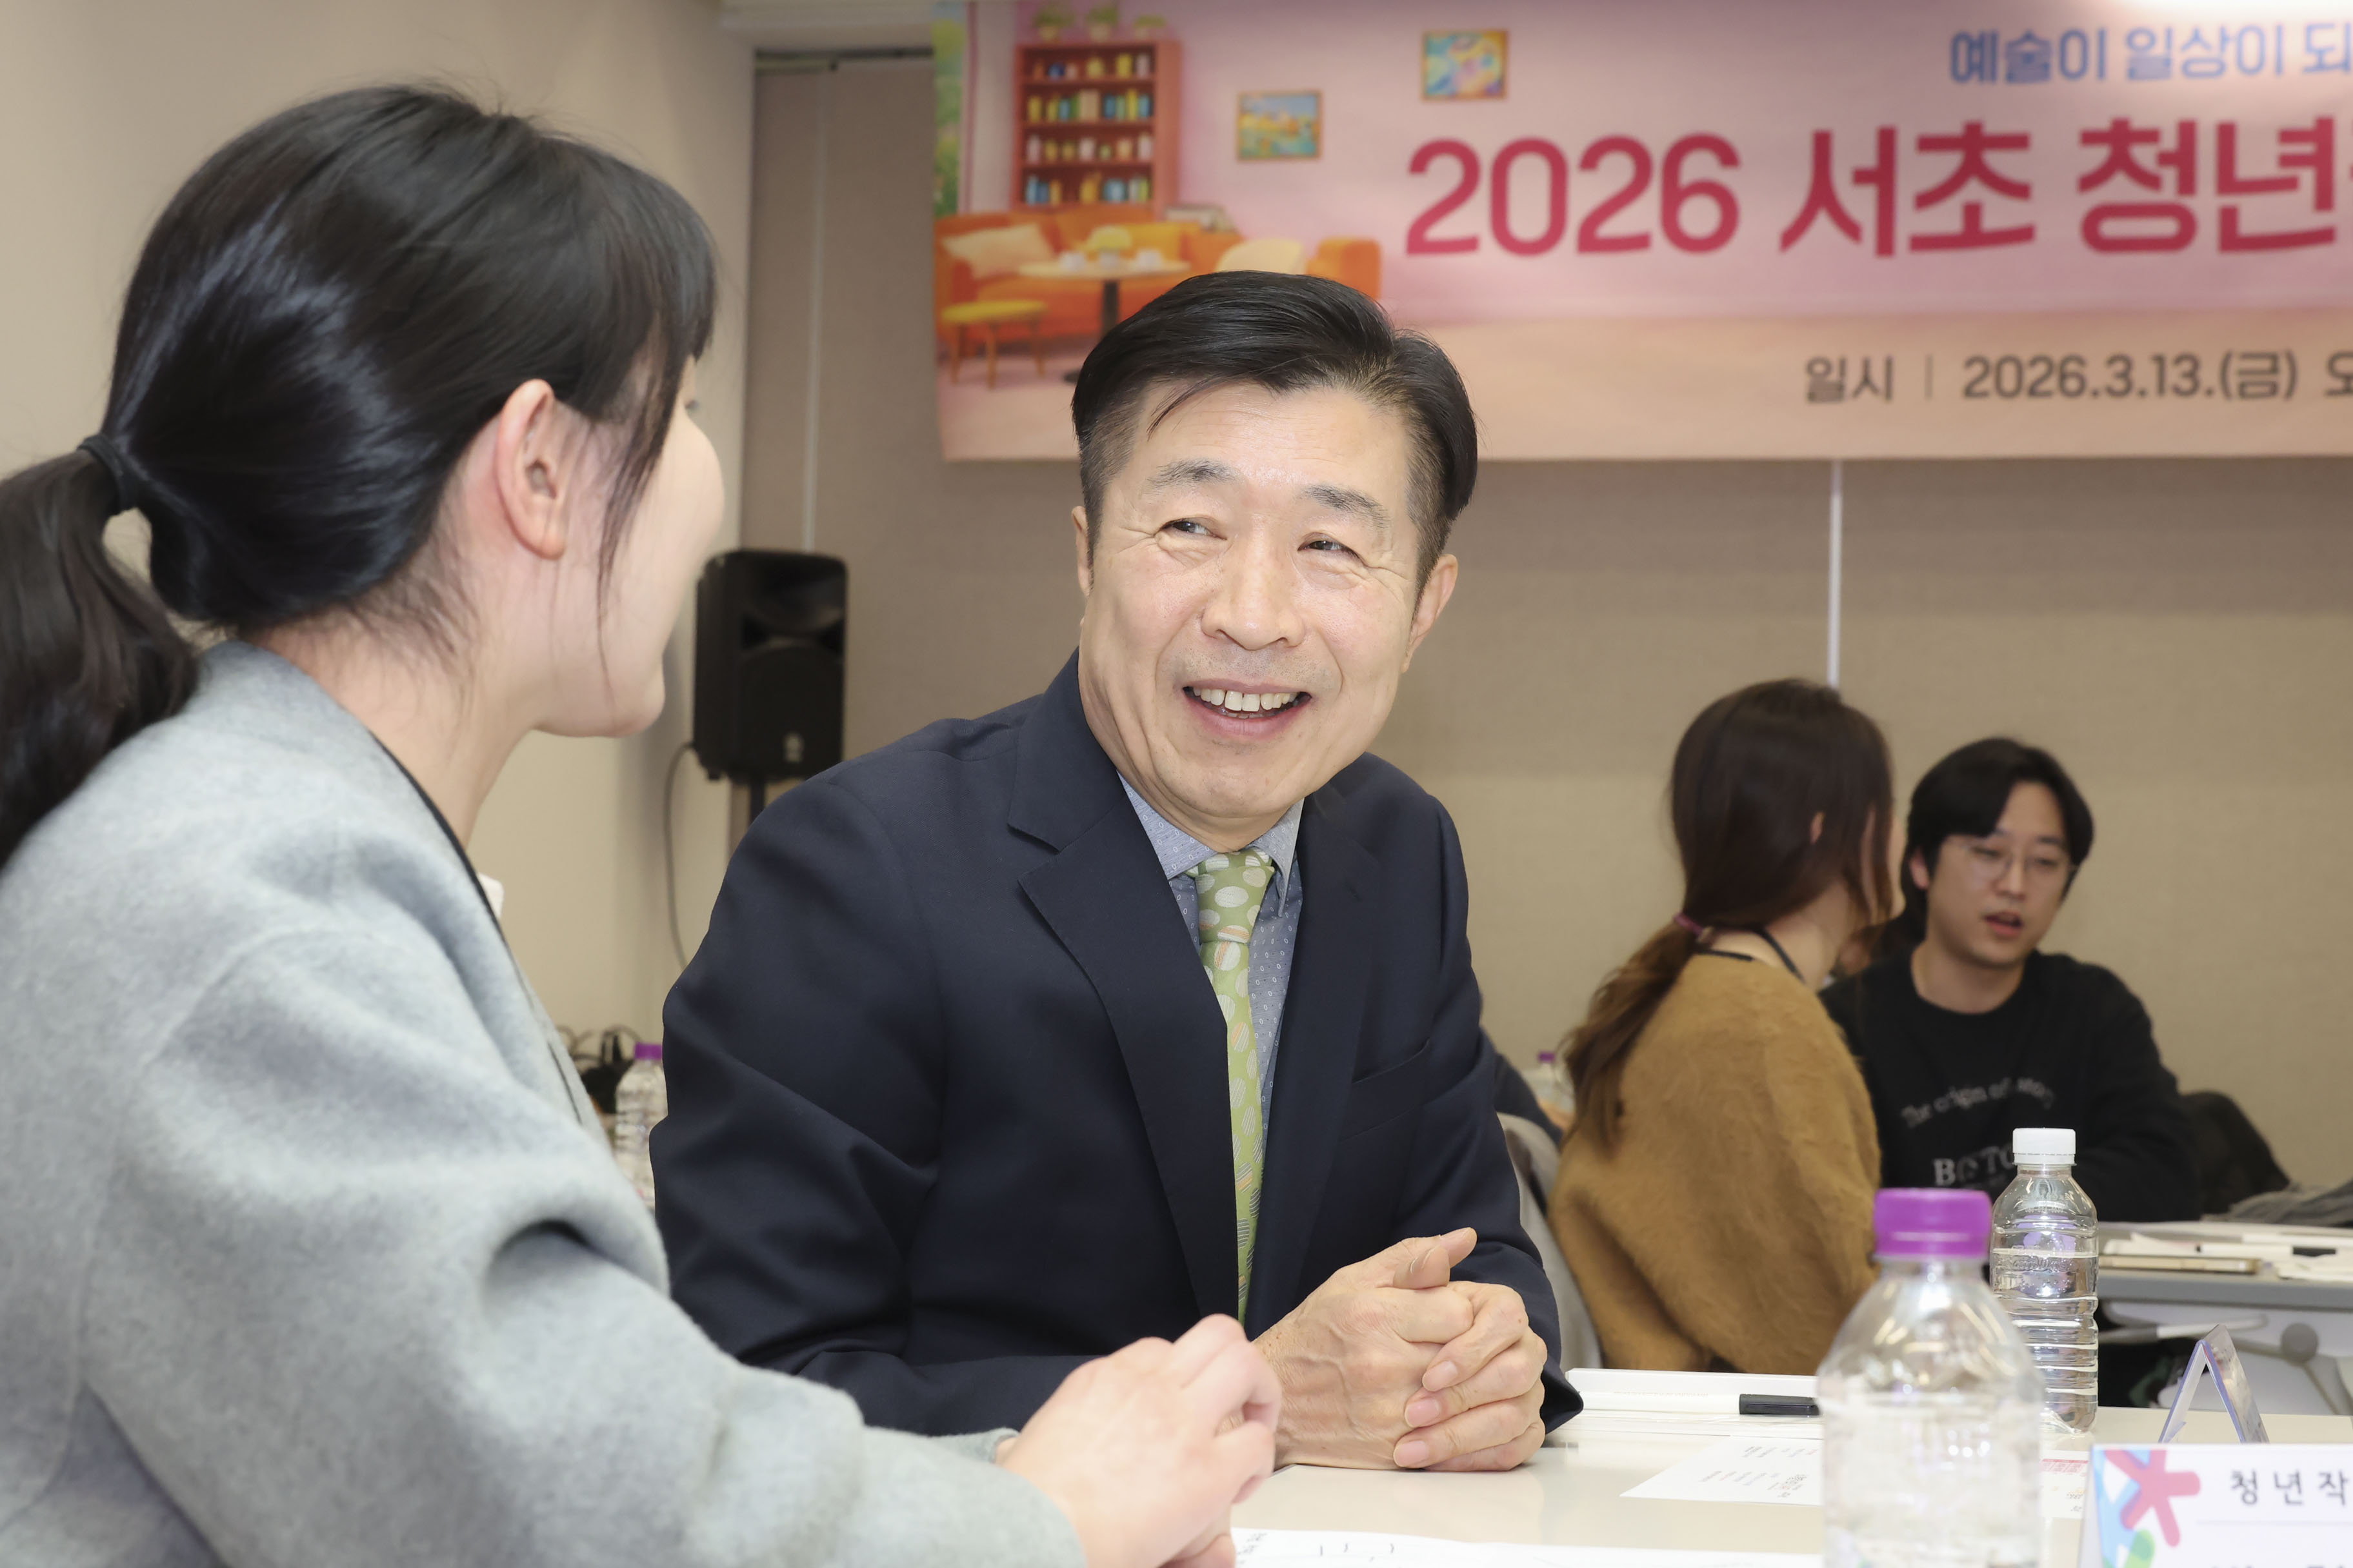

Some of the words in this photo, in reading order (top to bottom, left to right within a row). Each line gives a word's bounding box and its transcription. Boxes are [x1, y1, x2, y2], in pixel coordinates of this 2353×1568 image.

[1950, 28, 2107, 84] 예술이
[2125, 25, 2284, 81] 일상이
[1405, 134, 1741, 257] 2026
[1779, 121, 2037, 257] 서초
[2076, 116, 2353, 254] 청년
[1805, 355, 1894, 404] 일시
[1961, 349, 2299, 401] 2026.3.13.(금)
